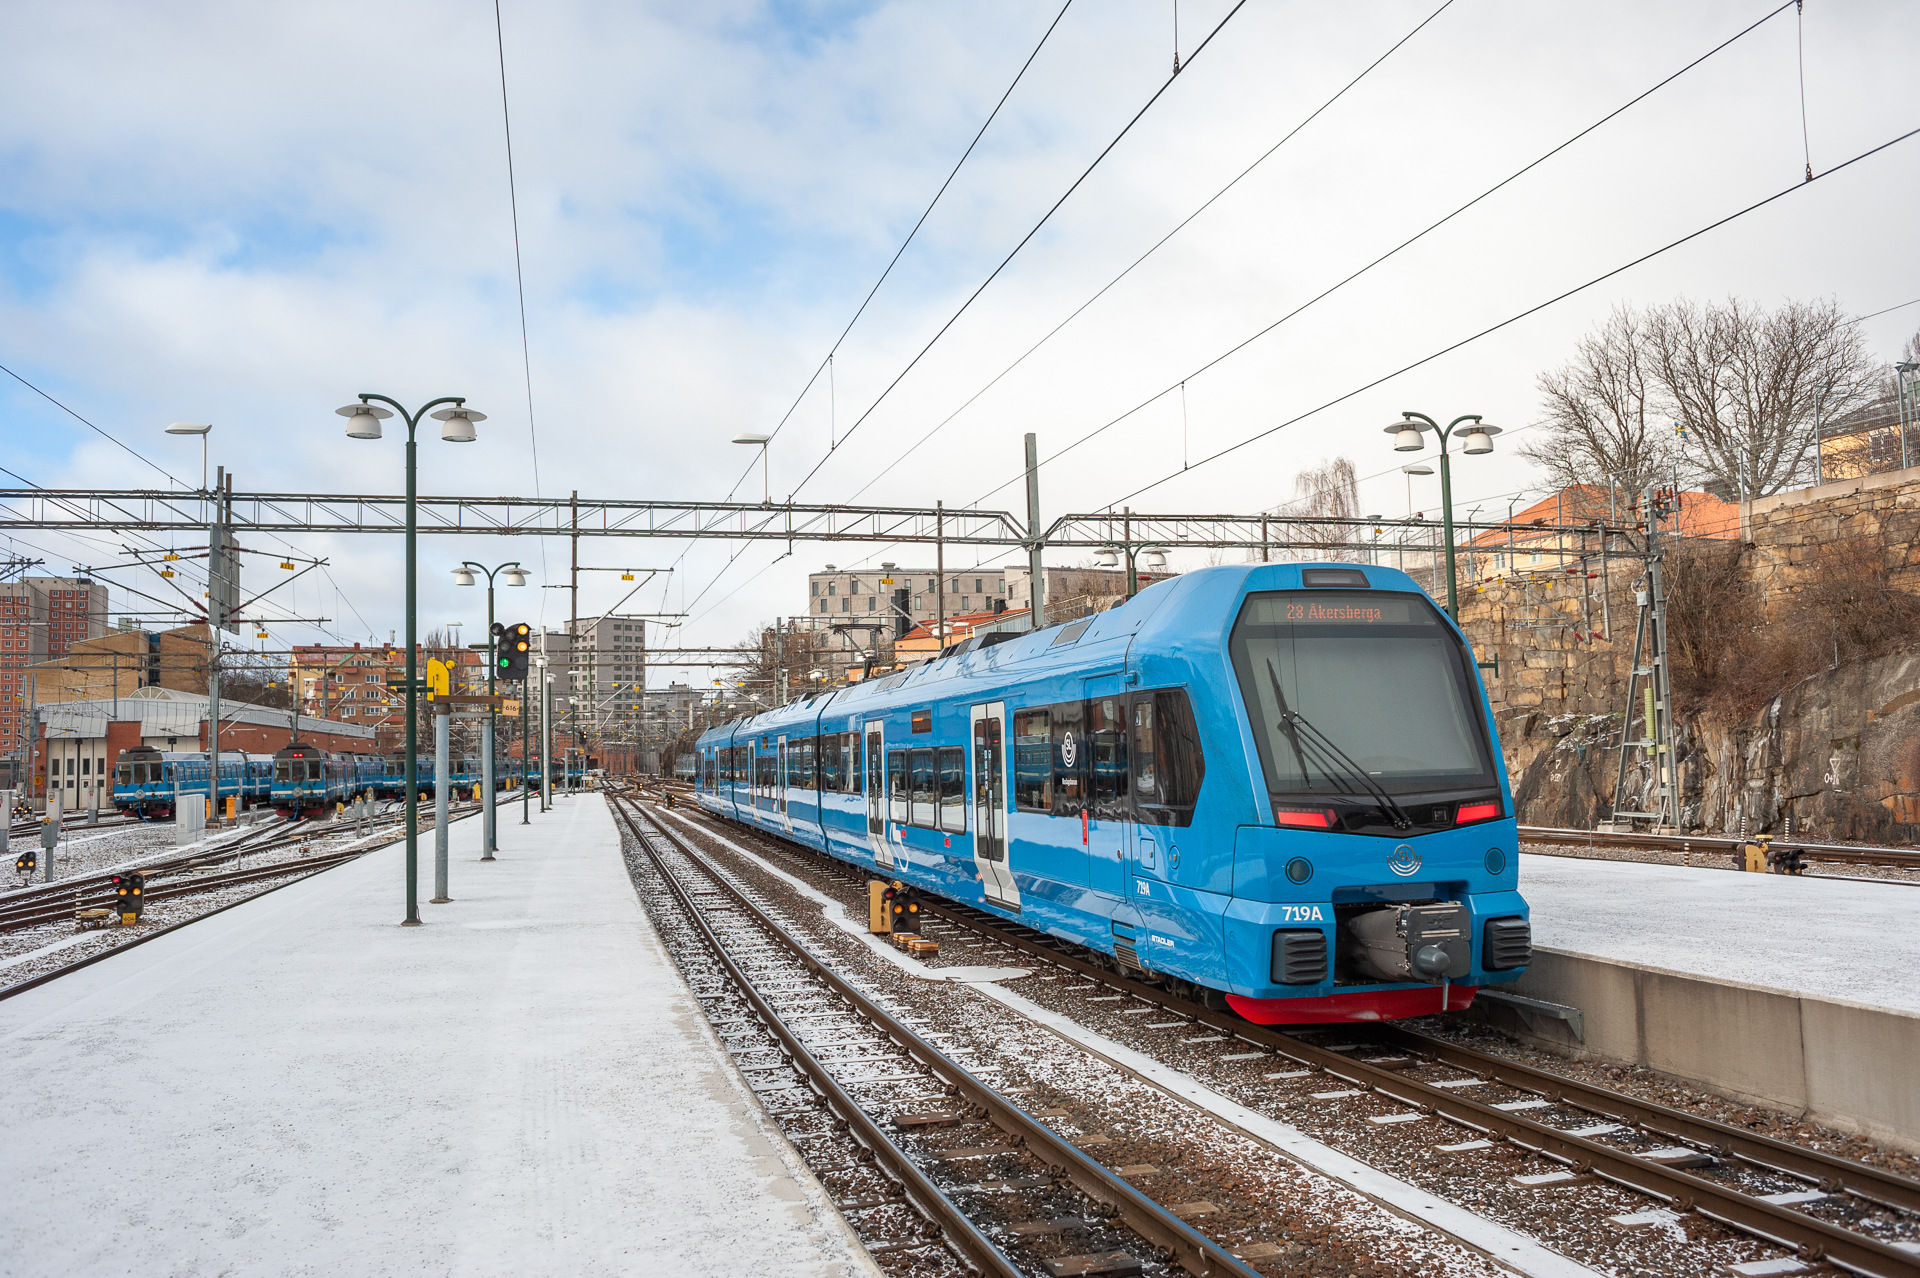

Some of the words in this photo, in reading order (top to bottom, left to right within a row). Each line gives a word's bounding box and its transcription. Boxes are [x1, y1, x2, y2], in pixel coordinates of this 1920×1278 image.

[1287, 604, 1304, 619] 28
[1308, 603, 1382, 622] Åkersberga
[1066, 738, 1072, 750] SL
[1399, 851, 1411, 861] SL
[1136, 880, 1151, 896] 719A
[1282, 906, 1323, 921] 719A
[1151, 934, 1175, 948] STADLER
